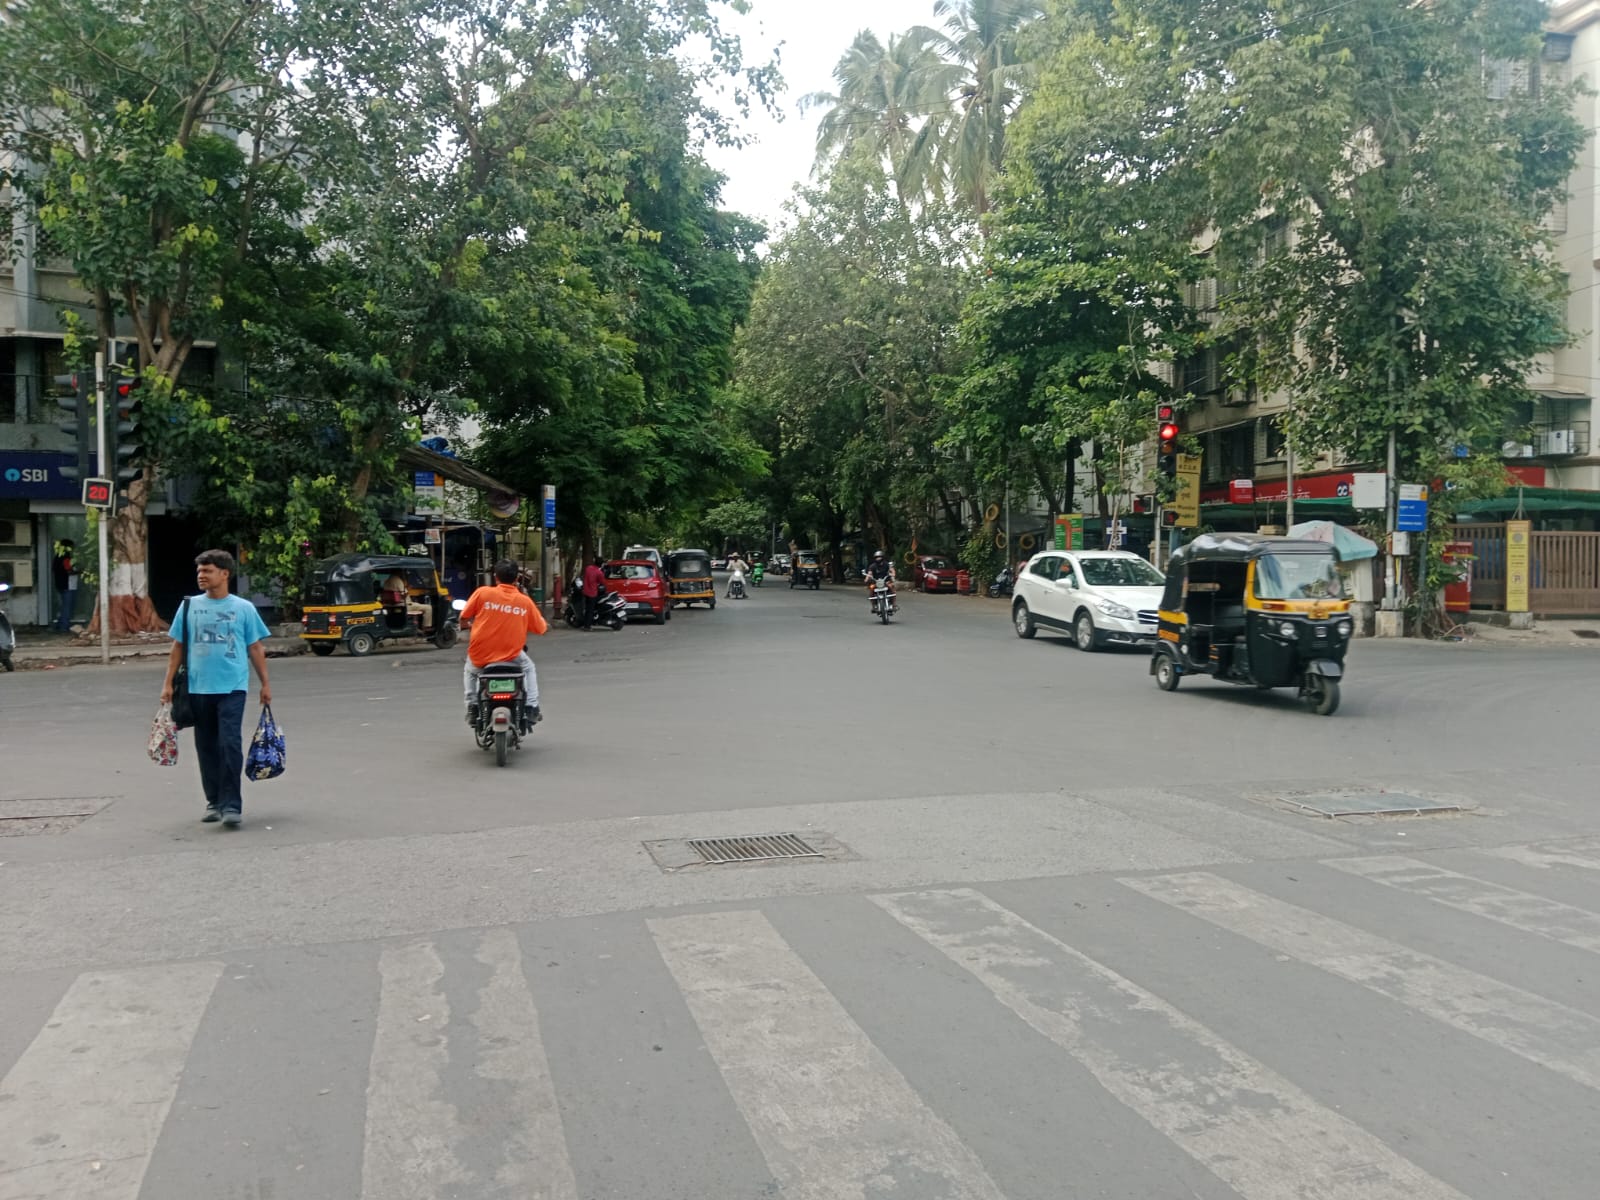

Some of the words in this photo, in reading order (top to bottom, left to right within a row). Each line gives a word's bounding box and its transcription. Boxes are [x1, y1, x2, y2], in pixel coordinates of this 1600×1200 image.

[21, 469, 48, 482] SBI
[88, 485, 108, 500] 20
[484, 601, 528, 617] SWIGGY
